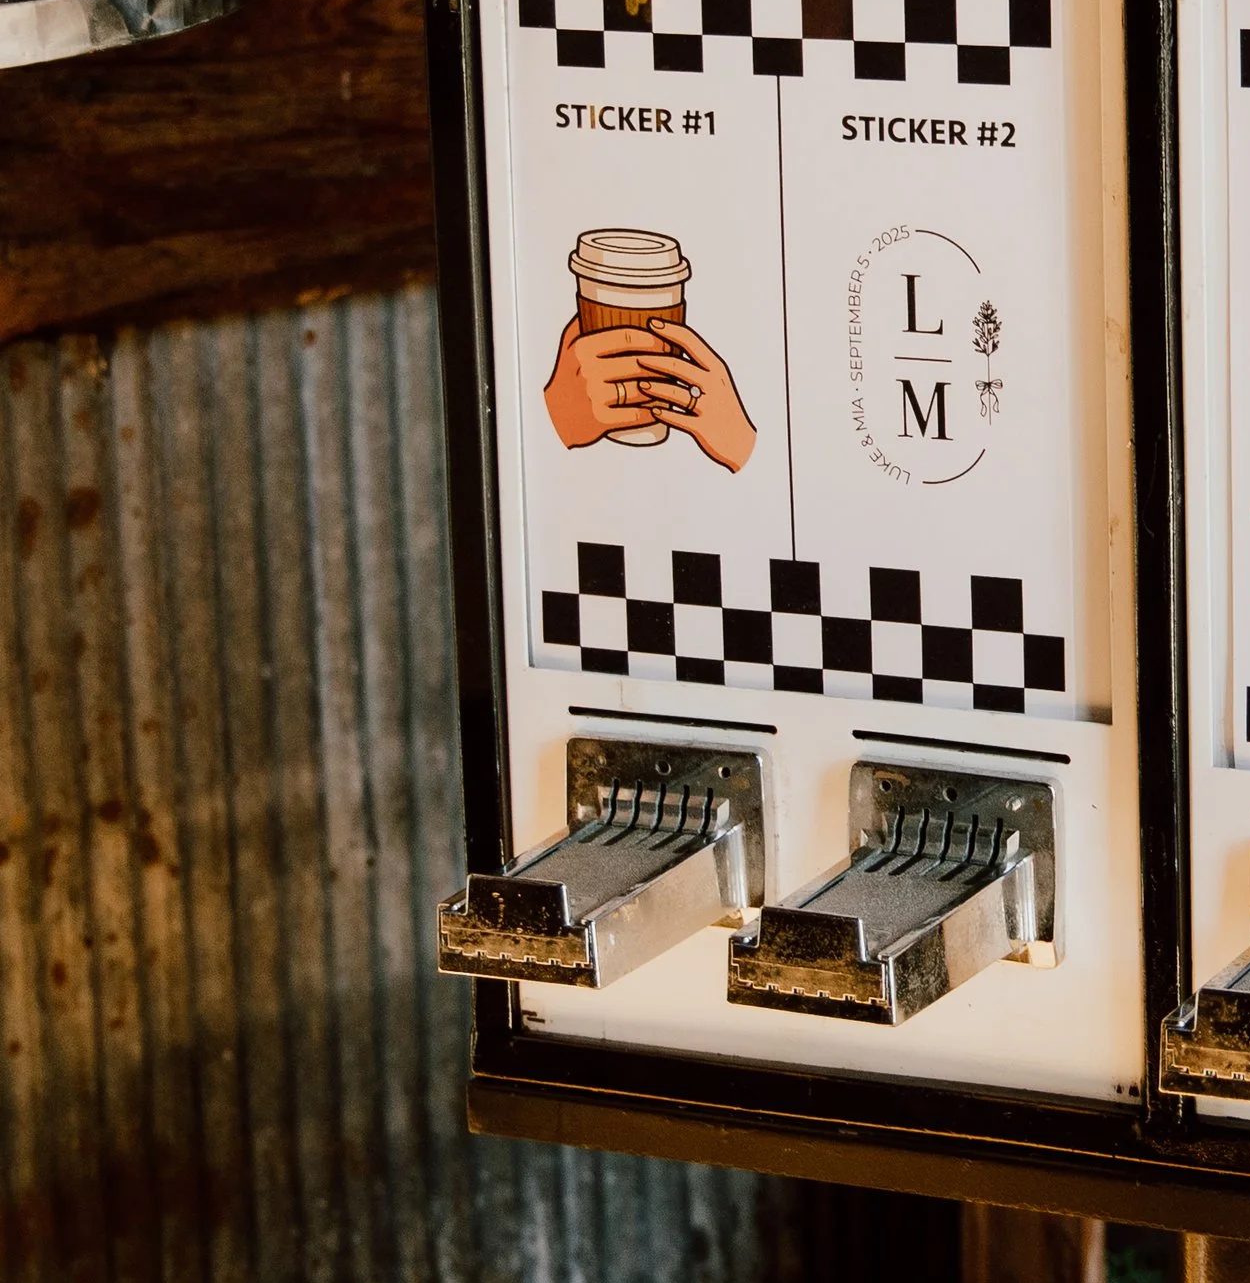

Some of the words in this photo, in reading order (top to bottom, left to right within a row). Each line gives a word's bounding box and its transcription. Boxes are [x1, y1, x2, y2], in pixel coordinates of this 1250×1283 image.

[555, 103, 674, 134] STICKER
[681, 109, 716, 136] #1
[841, 114, 969, 146] STICKER
[976, 121, 1017, 148] #2
[871, 224, 911, 253] 2025
[856, 254, 871, 270] 5
[900, 273, 944, 336] L
[847, 268, 866, 382] SEPTEMBER
[851, 396, 868, 432] MIA
[895, 378, 954, 441] M
[860, 433, 875, 448] &
[868, 447, 911, 485] LUKE
